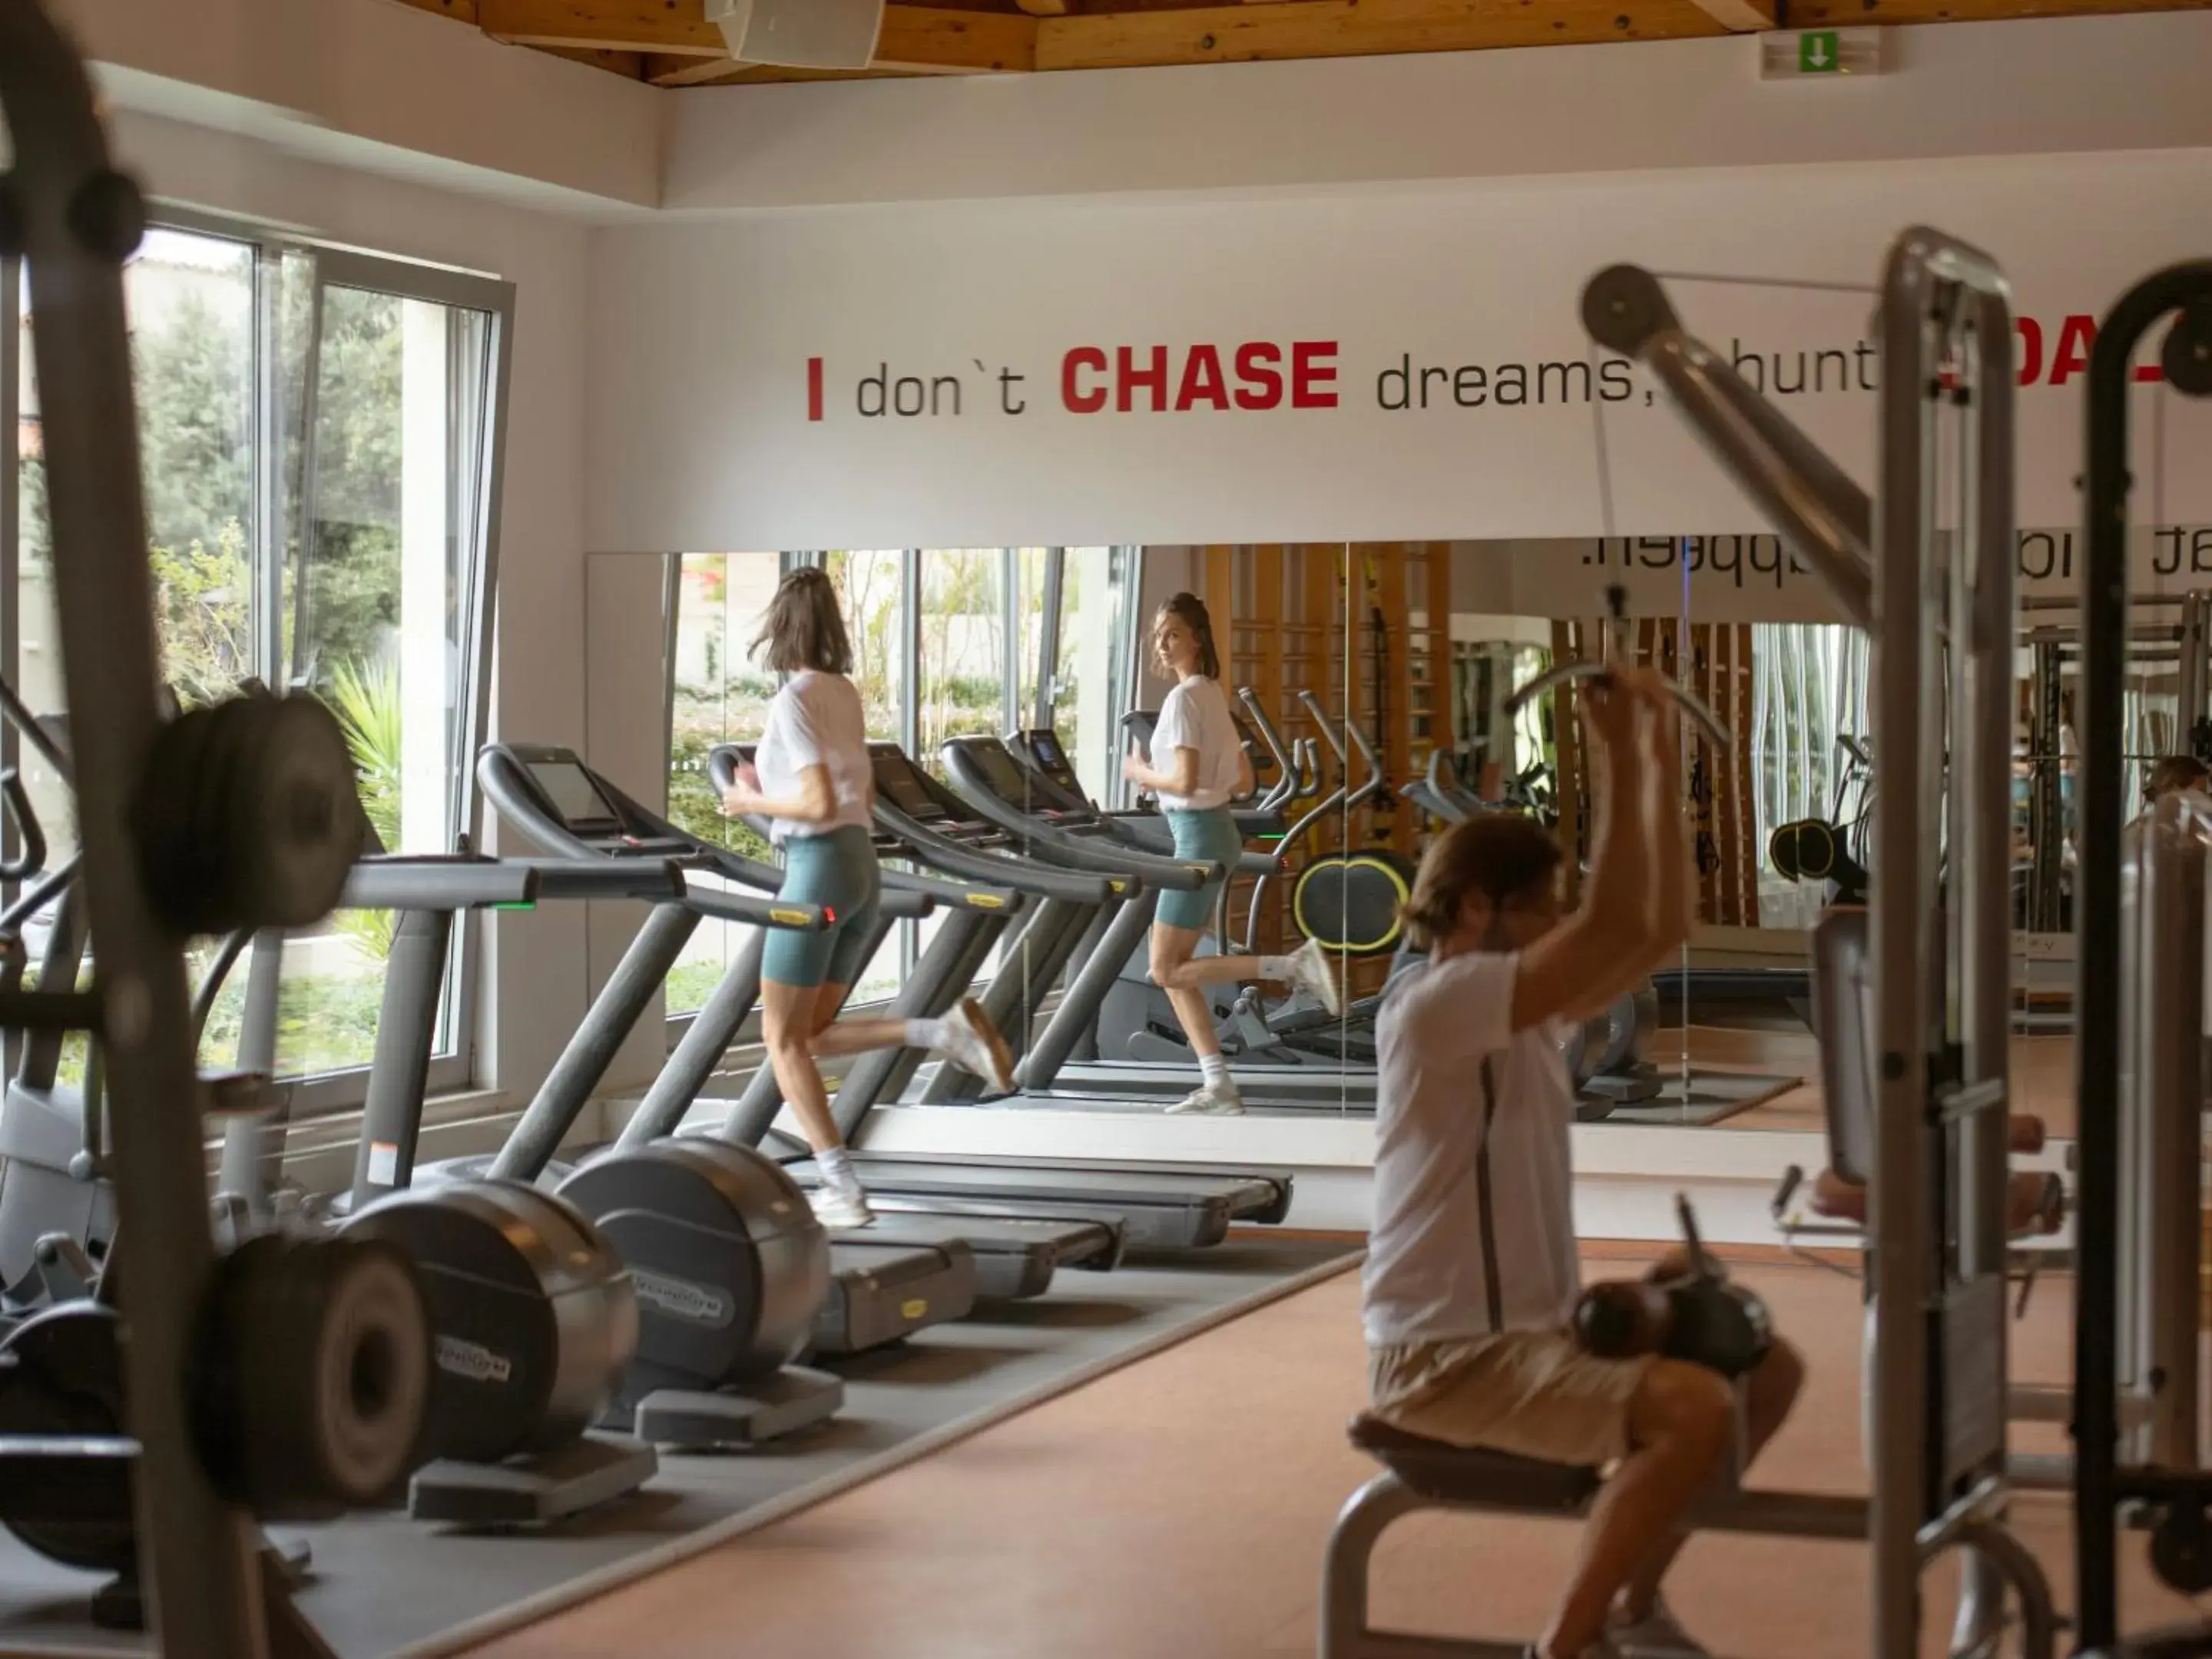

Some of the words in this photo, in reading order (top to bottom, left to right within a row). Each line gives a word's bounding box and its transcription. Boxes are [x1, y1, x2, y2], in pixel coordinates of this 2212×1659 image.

[808, 357, 823, 420] I
[1061, 341, 1338, 413] CHASE
[1376, 353, 1654, 410] dreams,
[1732, 338, 1879, 394] hunt
